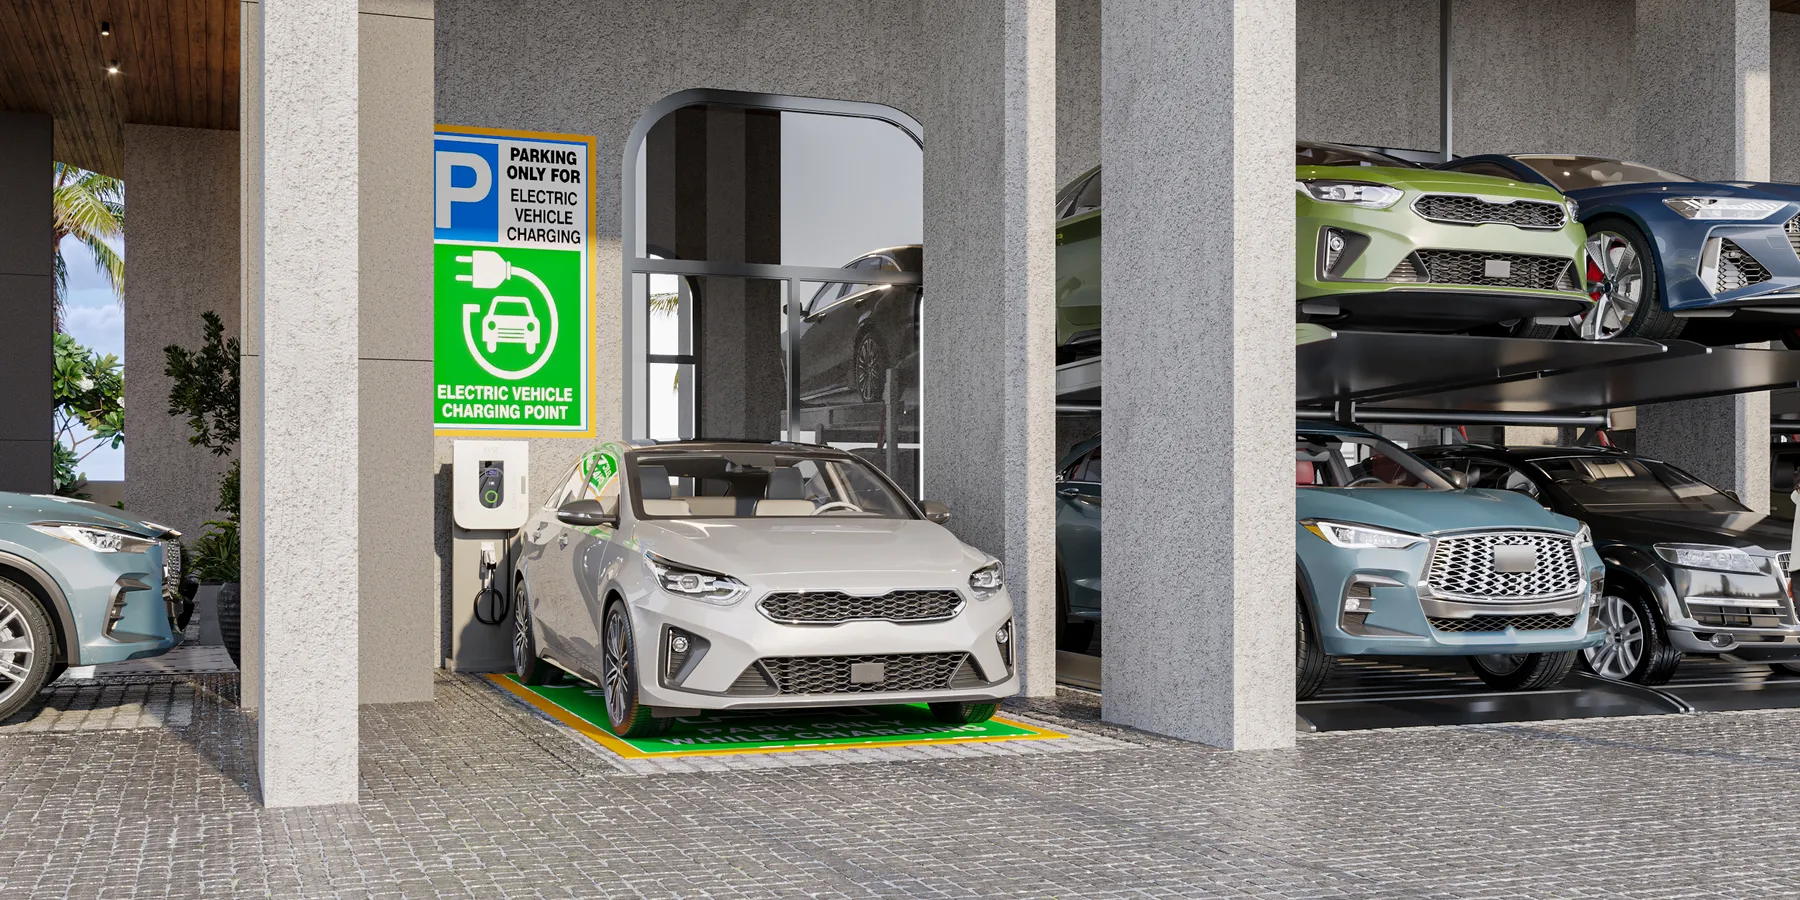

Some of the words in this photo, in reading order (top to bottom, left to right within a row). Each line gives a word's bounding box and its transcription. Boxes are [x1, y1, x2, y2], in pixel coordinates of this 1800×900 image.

[511, 147, 576, 166] PARKING
[507, 165, 546, 181] ONLY
[551, 168, 580, 183] FOR
[436, 151, 492, 228] P
[511, 189, 577, 206] ELECTRIC
[515, 208, 573, 225] VEHICLE
[507, 227, 580, 244] CHARGING
[438, 385, 508, 400] ELECTRIC
[512, 387, 572, 402] VEHICLE
[442, 403, 520, 419] CHARGING
[525, 405, 568, 419] POINT
[661, 733, 789, 745] WHILE
[794, 724, 987, 739] CHARGING
[697, 725, 804, 735] PARK
[811, 719, 904, 730] ONLY
